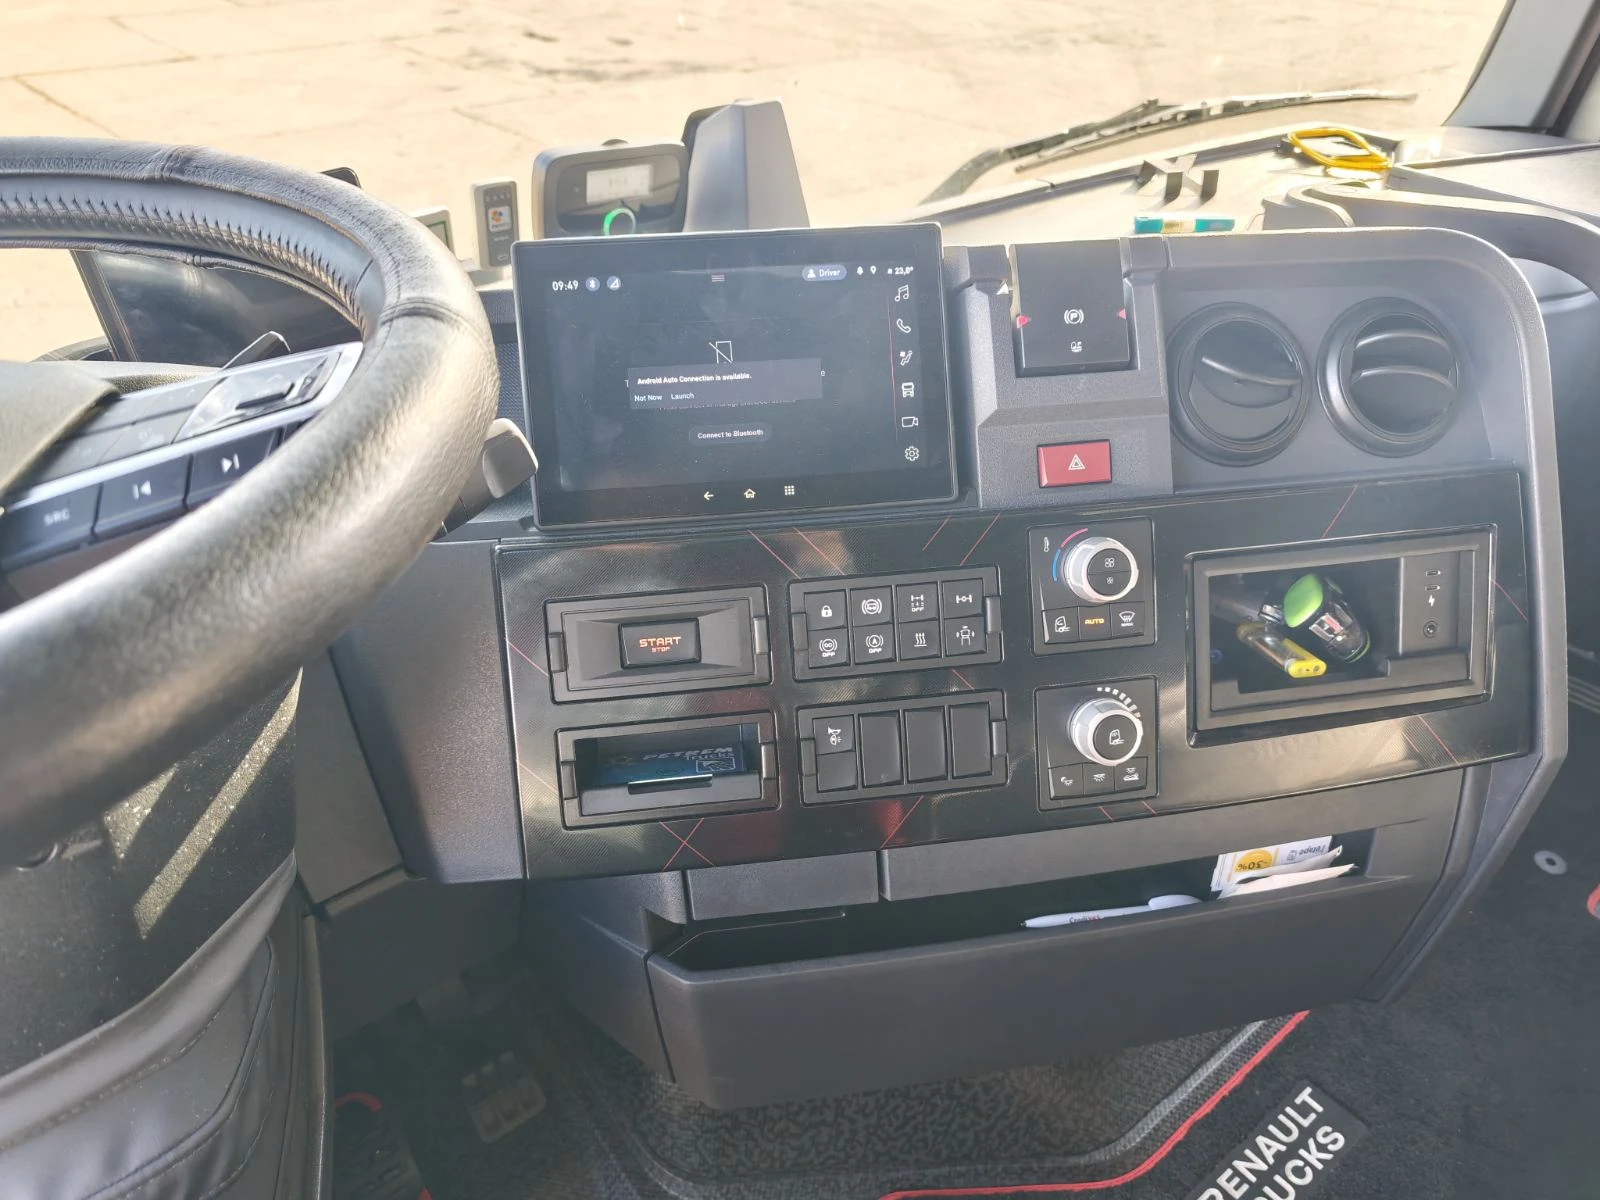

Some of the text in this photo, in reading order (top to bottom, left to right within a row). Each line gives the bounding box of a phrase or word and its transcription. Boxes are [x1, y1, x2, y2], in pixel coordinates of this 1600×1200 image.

[819, 269, 841, 277] Driver
[552, 280, 579, 291] 09:49
[637, 376, 662, 385] Android
[663, 376, 678, 384] Auto
[679, 374, 715, 383] Connection
[671, 392, 695, 400] Launch
[733, 429, 764, 437] Bluetooth
[639, 636, 682, 648] START
[1254, 1125, 1345, 1200] UCKS
